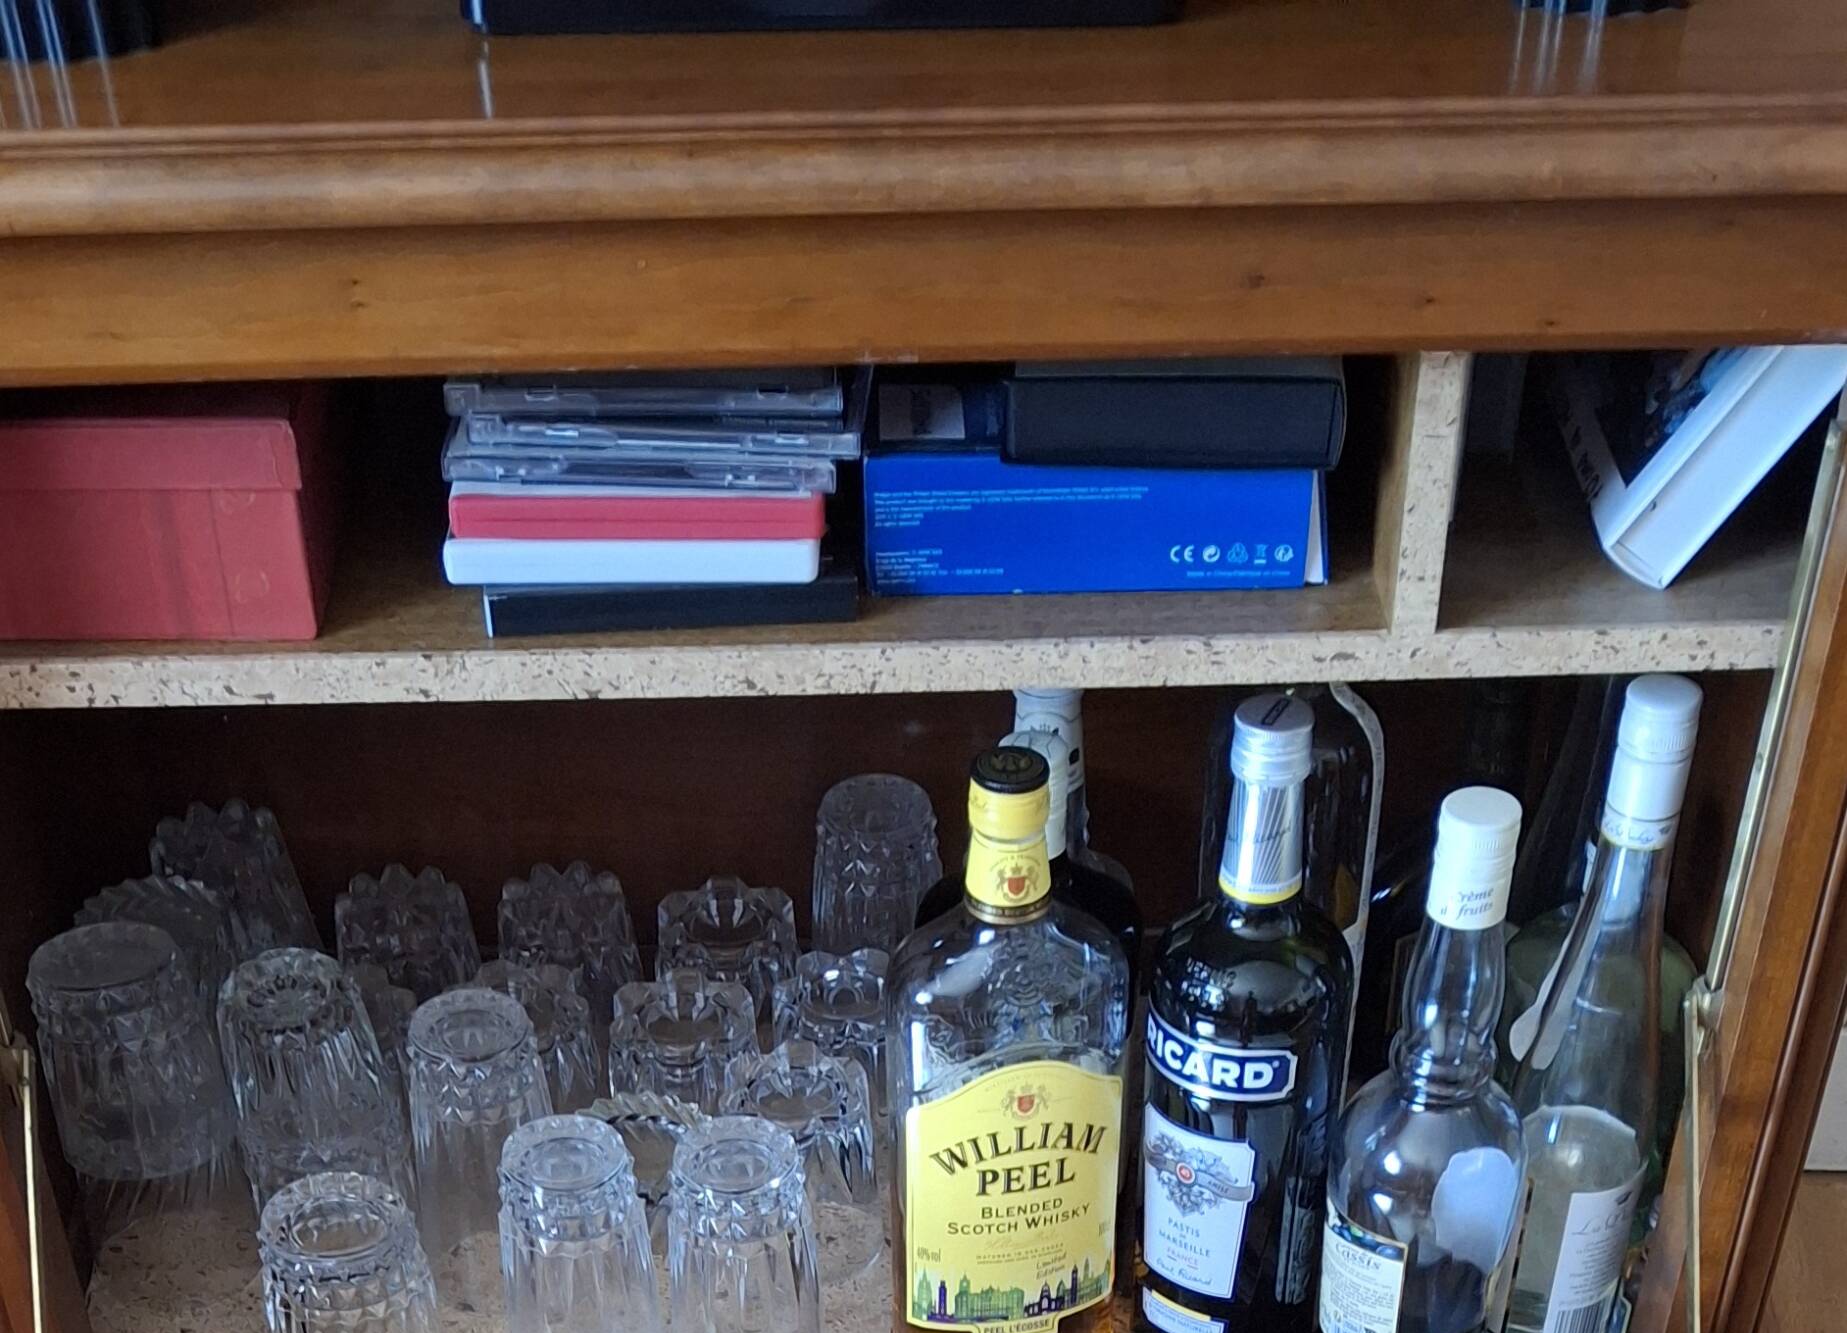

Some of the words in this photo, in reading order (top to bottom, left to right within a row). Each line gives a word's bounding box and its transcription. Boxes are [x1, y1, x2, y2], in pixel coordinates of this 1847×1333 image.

[1456, 902, 1494, 921] fruits
[1147, 1012, 1274, 1090] RICARD
[929, 1121, 1107, 1176] WILLIAM
[976, 1157, 1076, 1197] PEEL
[947, 1220, 1018, 1236] SCOTCH
[1026, 1203, 1090, 1230] WHISKY
[981, 1197, 1063, 1220] BLENDED
